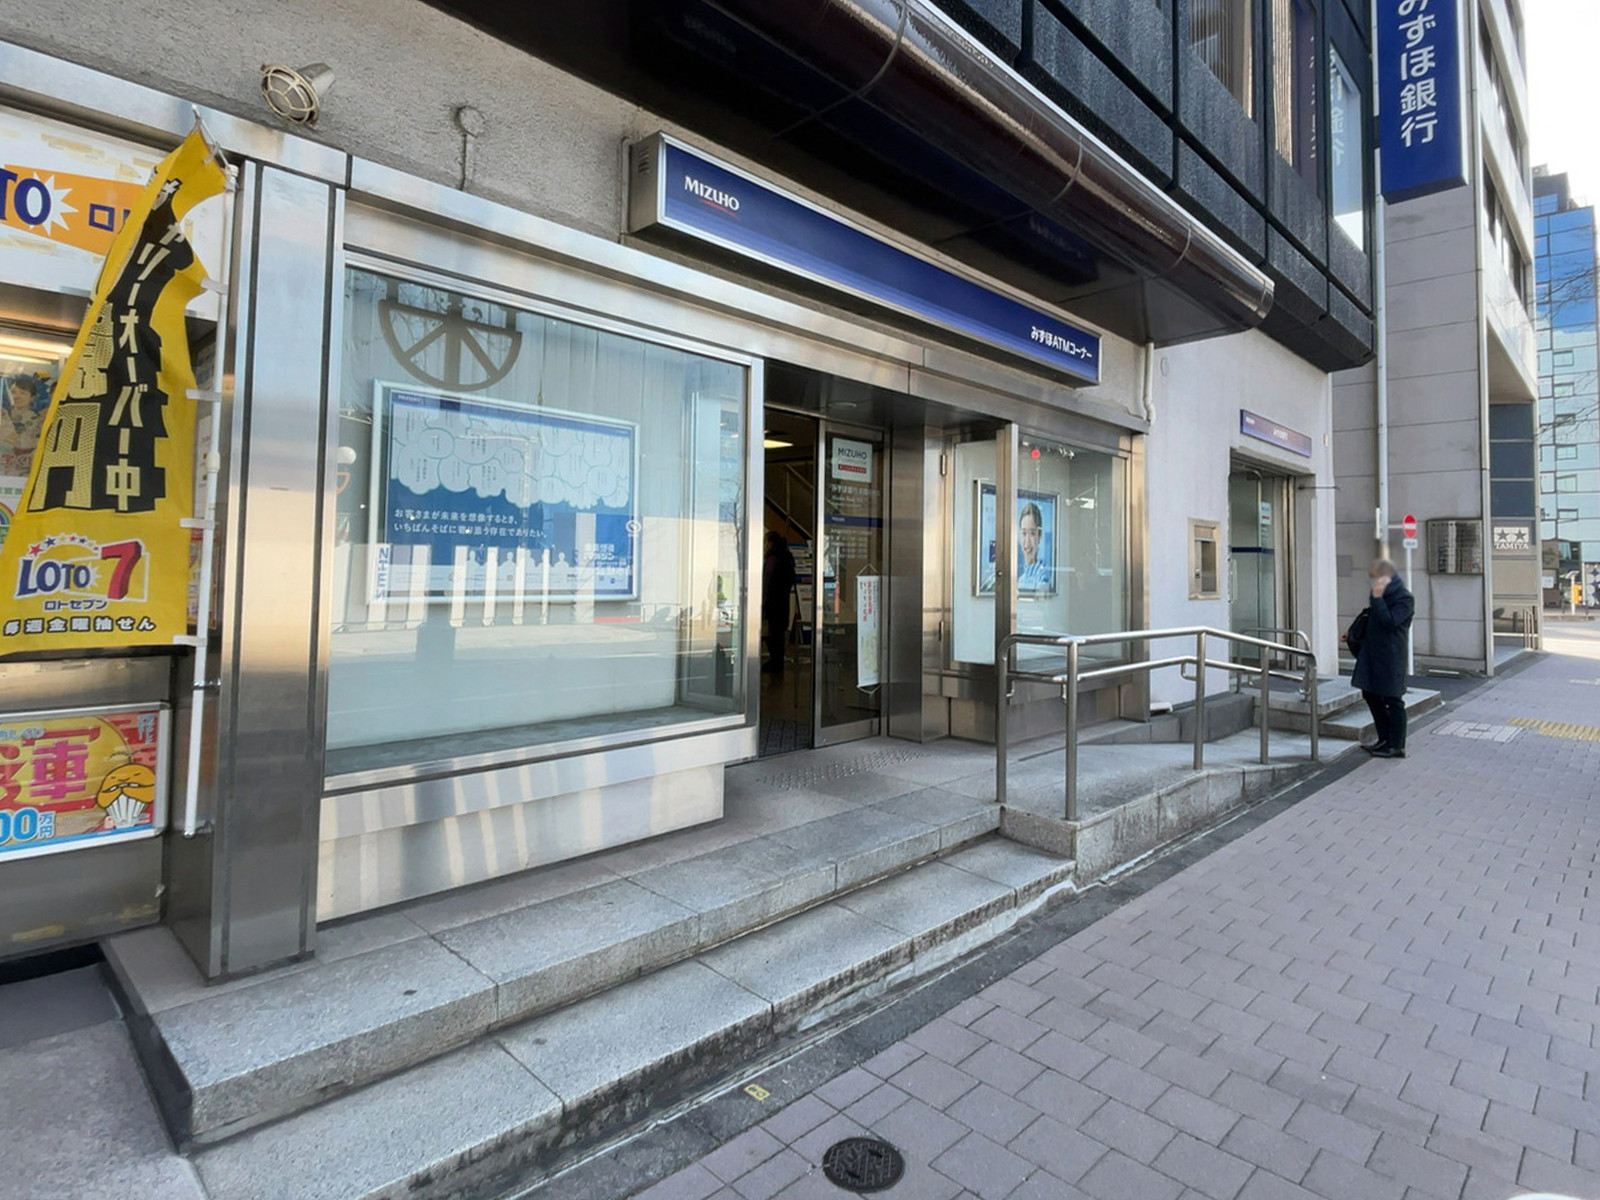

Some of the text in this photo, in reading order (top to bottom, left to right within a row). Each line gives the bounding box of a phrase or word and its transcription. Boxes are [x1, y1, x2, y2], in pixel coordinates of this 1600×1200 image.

[684, 175, 740, 211] MIZUHO
[1030, 325, 1093, 359] みずほATMコーナー
[837, 447, 867, 460] MIZUHO
[1494, 541, 1530, 550] TAMIYA
[16, 541, 142, 600] LOTO 7
[44, 599, 108, 611] ロトセブン
[3, 616, 157, 636] 毎週金曜抽せん
